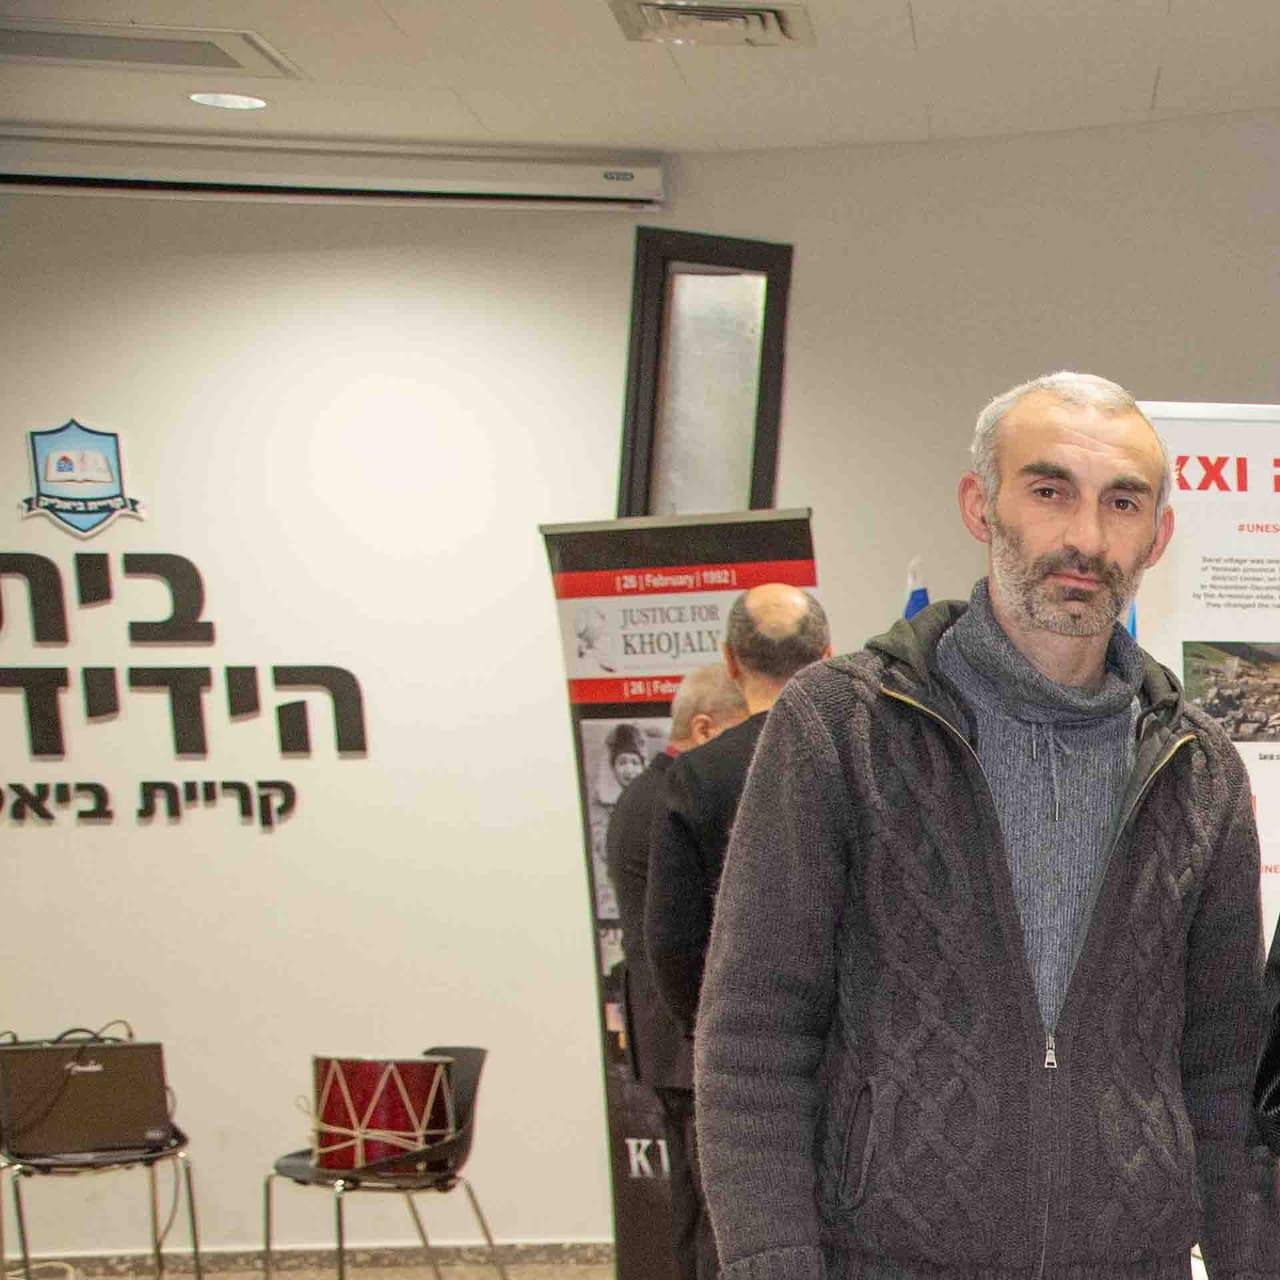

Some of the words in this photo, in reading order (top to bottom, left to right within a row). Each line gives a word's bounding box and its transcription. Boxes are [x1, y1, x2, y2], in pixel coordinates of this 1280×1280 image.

[645, 573, 694, 589] February
[701, 570, 731, 586] 1992
[621, 605, 689, 629] JUSTICE
[690, 604, 720, 624] FOR
[621, 630, 721, 658] KHOJALY
[0, 782, 115, 820] ביא
[137, 780, 297, 828] קריית
